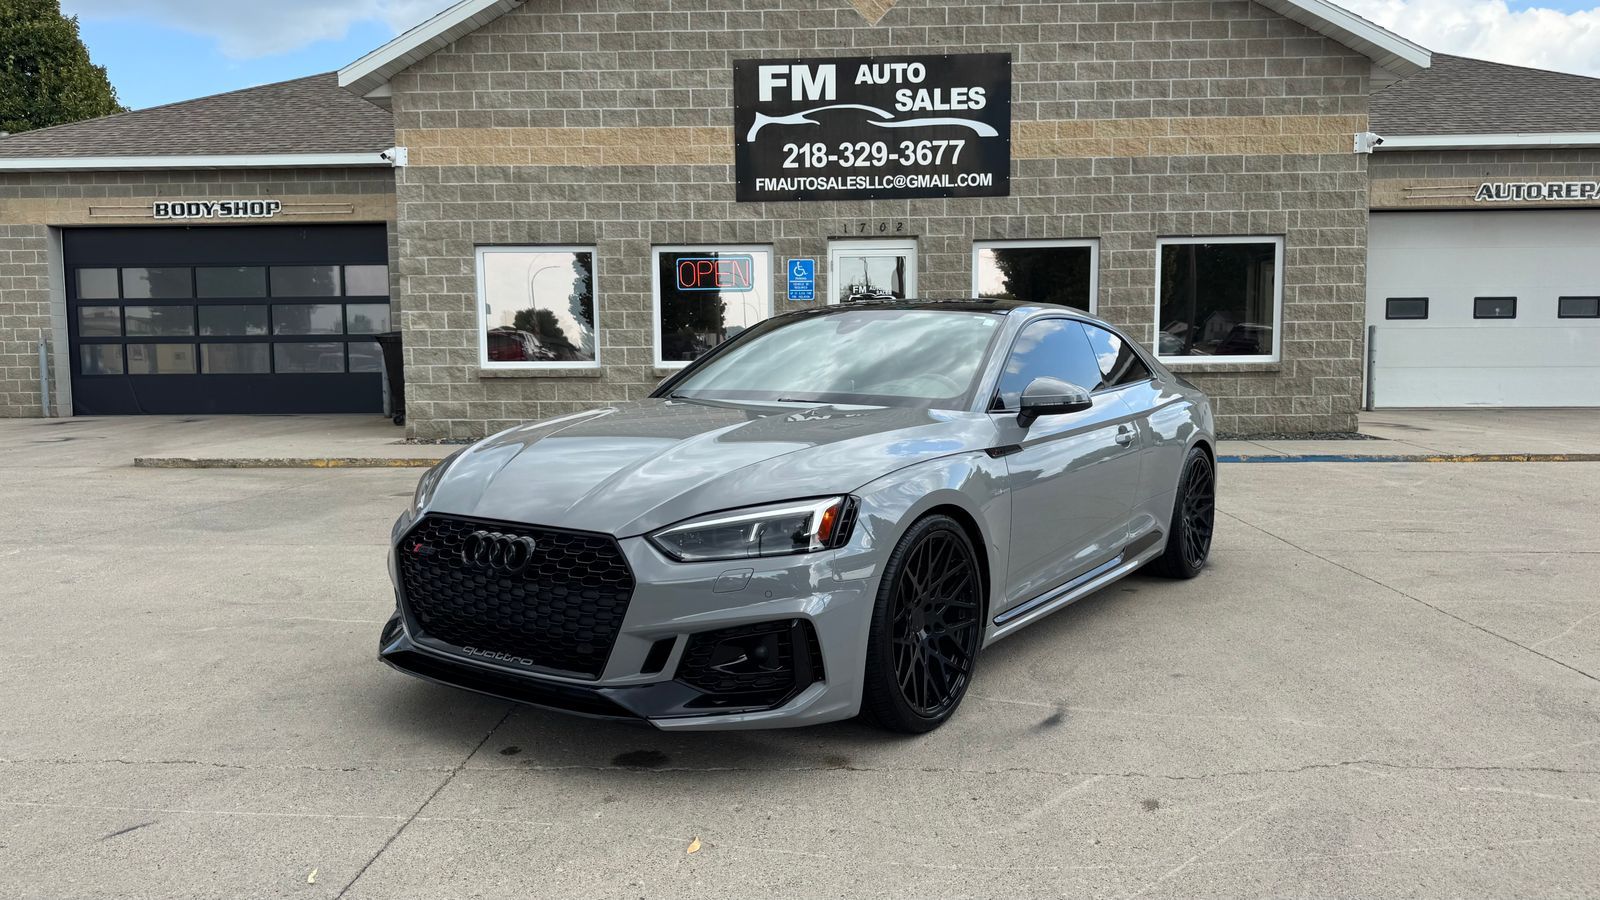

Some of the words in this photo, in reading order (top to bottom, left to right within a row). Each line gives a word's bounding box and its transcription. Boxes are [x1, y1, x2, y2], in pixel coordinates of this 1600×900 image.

[758, 64, 836, 101] FM
[855, 63, 926, 85] AUTO
[895, 87, 987, 112] SALES
[782, 140, 966, 168] 218-329-3677
[755, 173, 992, 191] FMAUTOSALESLLC@GMAIL.COM
[1475, 182, 1544, 201] AUTO
[154, 201, 217, 218] BODY
[219, 200, 281, 217] SHOP
[843, 222, 903, 234] 1702
[680, 260, 749, 288] OPEN
[852, 286, 867, 295] FM
[462, 645, 534, 666] quattro
